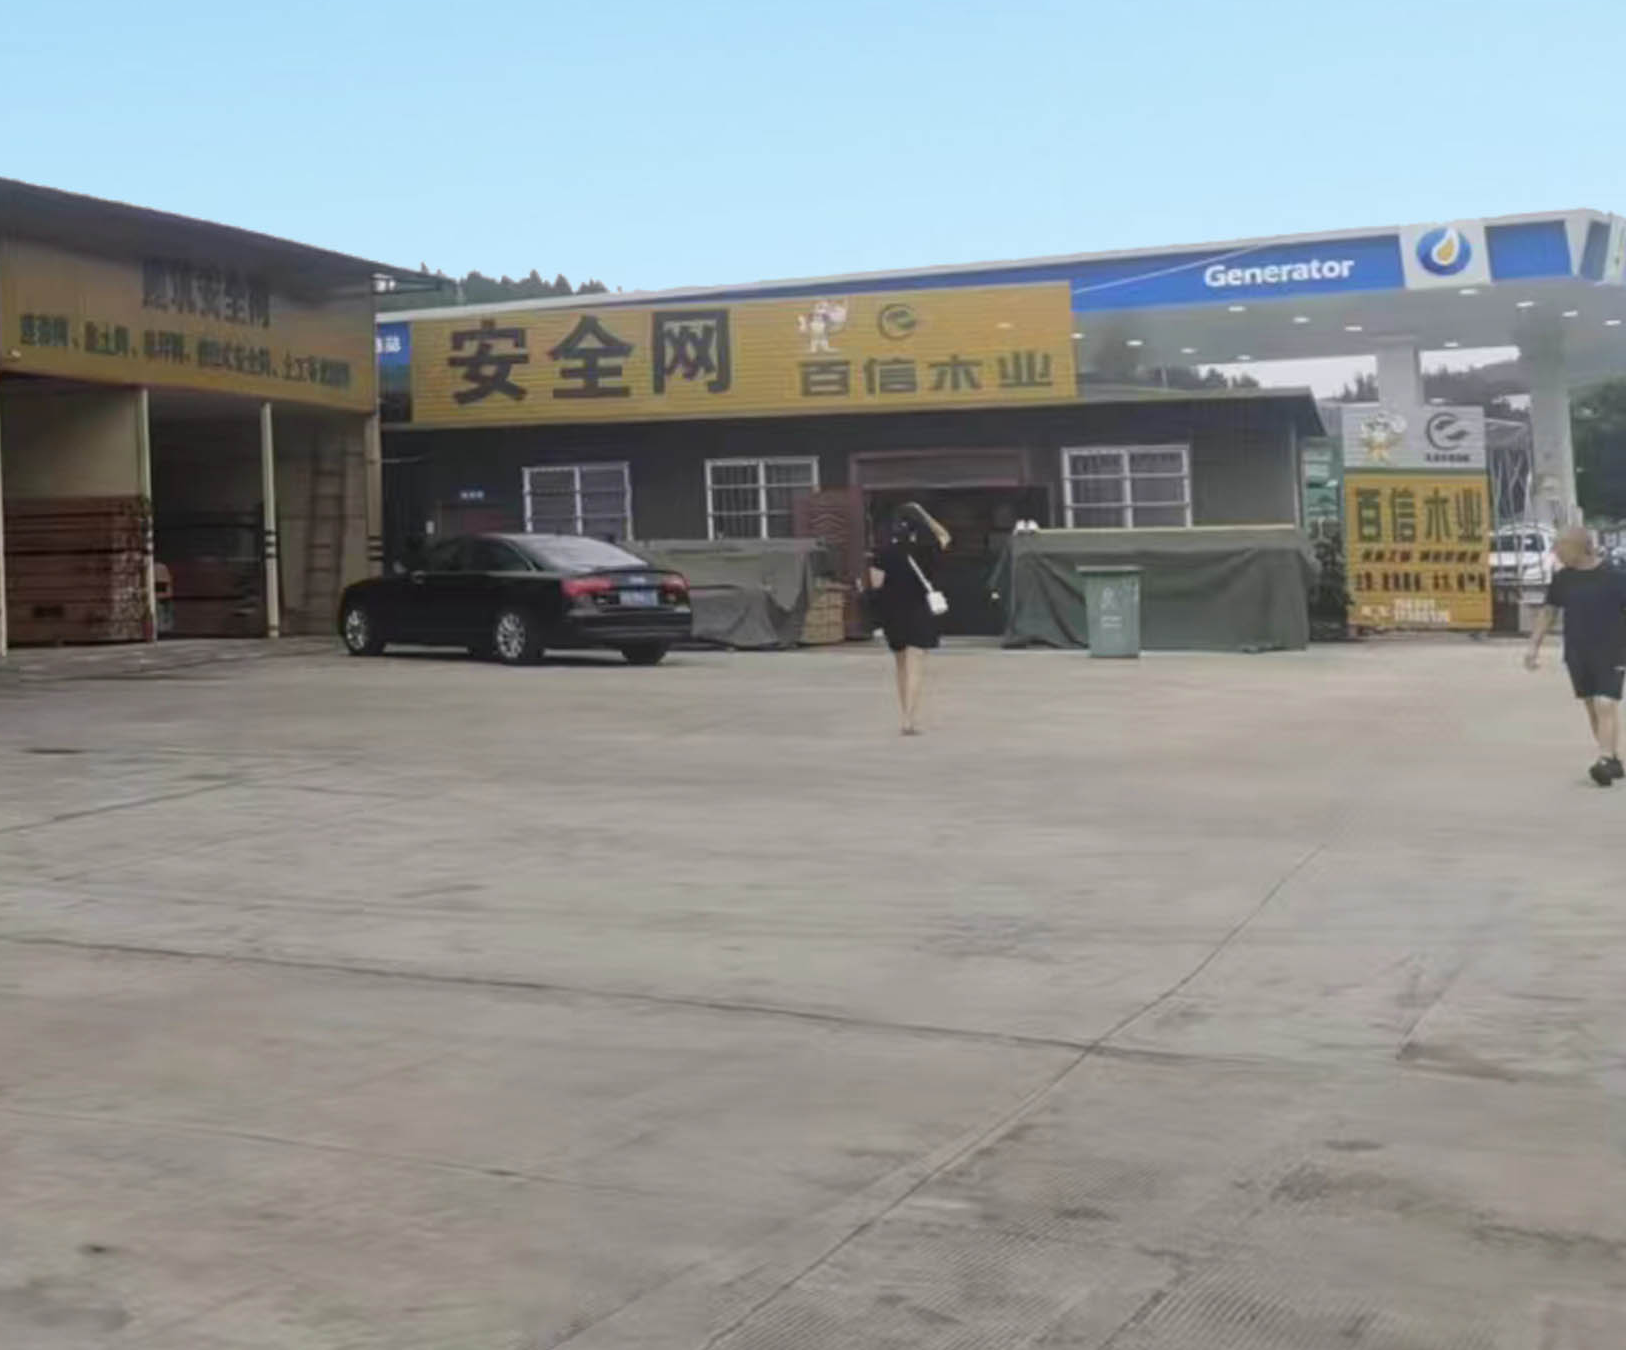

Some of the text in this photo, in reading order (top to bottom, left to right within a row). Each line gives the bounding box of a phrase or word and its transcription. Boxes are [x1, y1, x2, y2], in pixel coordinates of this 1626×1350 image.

[1203, 254, 1355, 291] Generator
[447, 309, 732, 405] 安全网
[800, 348, 1055, 398] 百信木业
[1355, 487, 1483, 543] 百信木业
